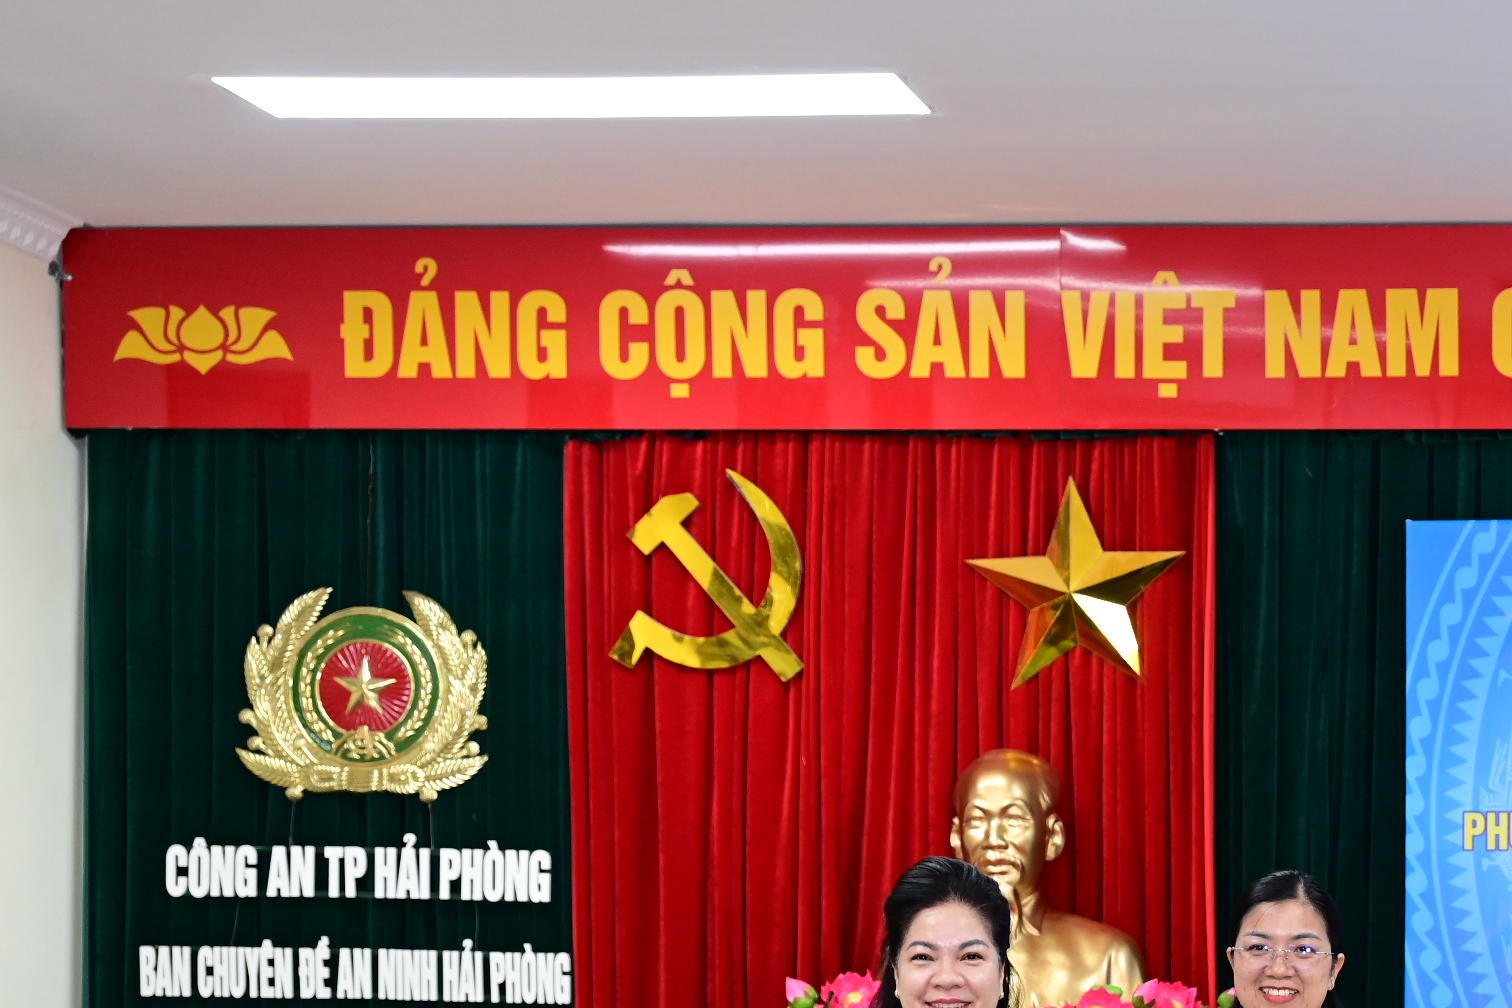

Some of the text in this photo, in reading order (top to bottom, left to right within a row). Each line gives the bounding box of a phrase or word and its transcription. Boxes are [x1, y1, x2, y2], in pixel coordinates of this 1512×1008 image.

[340, 257, 568, 379] ĐẢNG
[598, 268, 825, 398] CỘNG
[854, 257, 1026, 379] SẢN
[1062, 270, 1236, 398] VIỆT
[1265, 287, 1460, 378] NAM
[165, 832, 552, 903] CÔNG AN TP HẢI PHÒNG
[139, 935, 572, 1005] BAN CHUYÊN ĐỀ AN NINH HẢI PHÒNG
